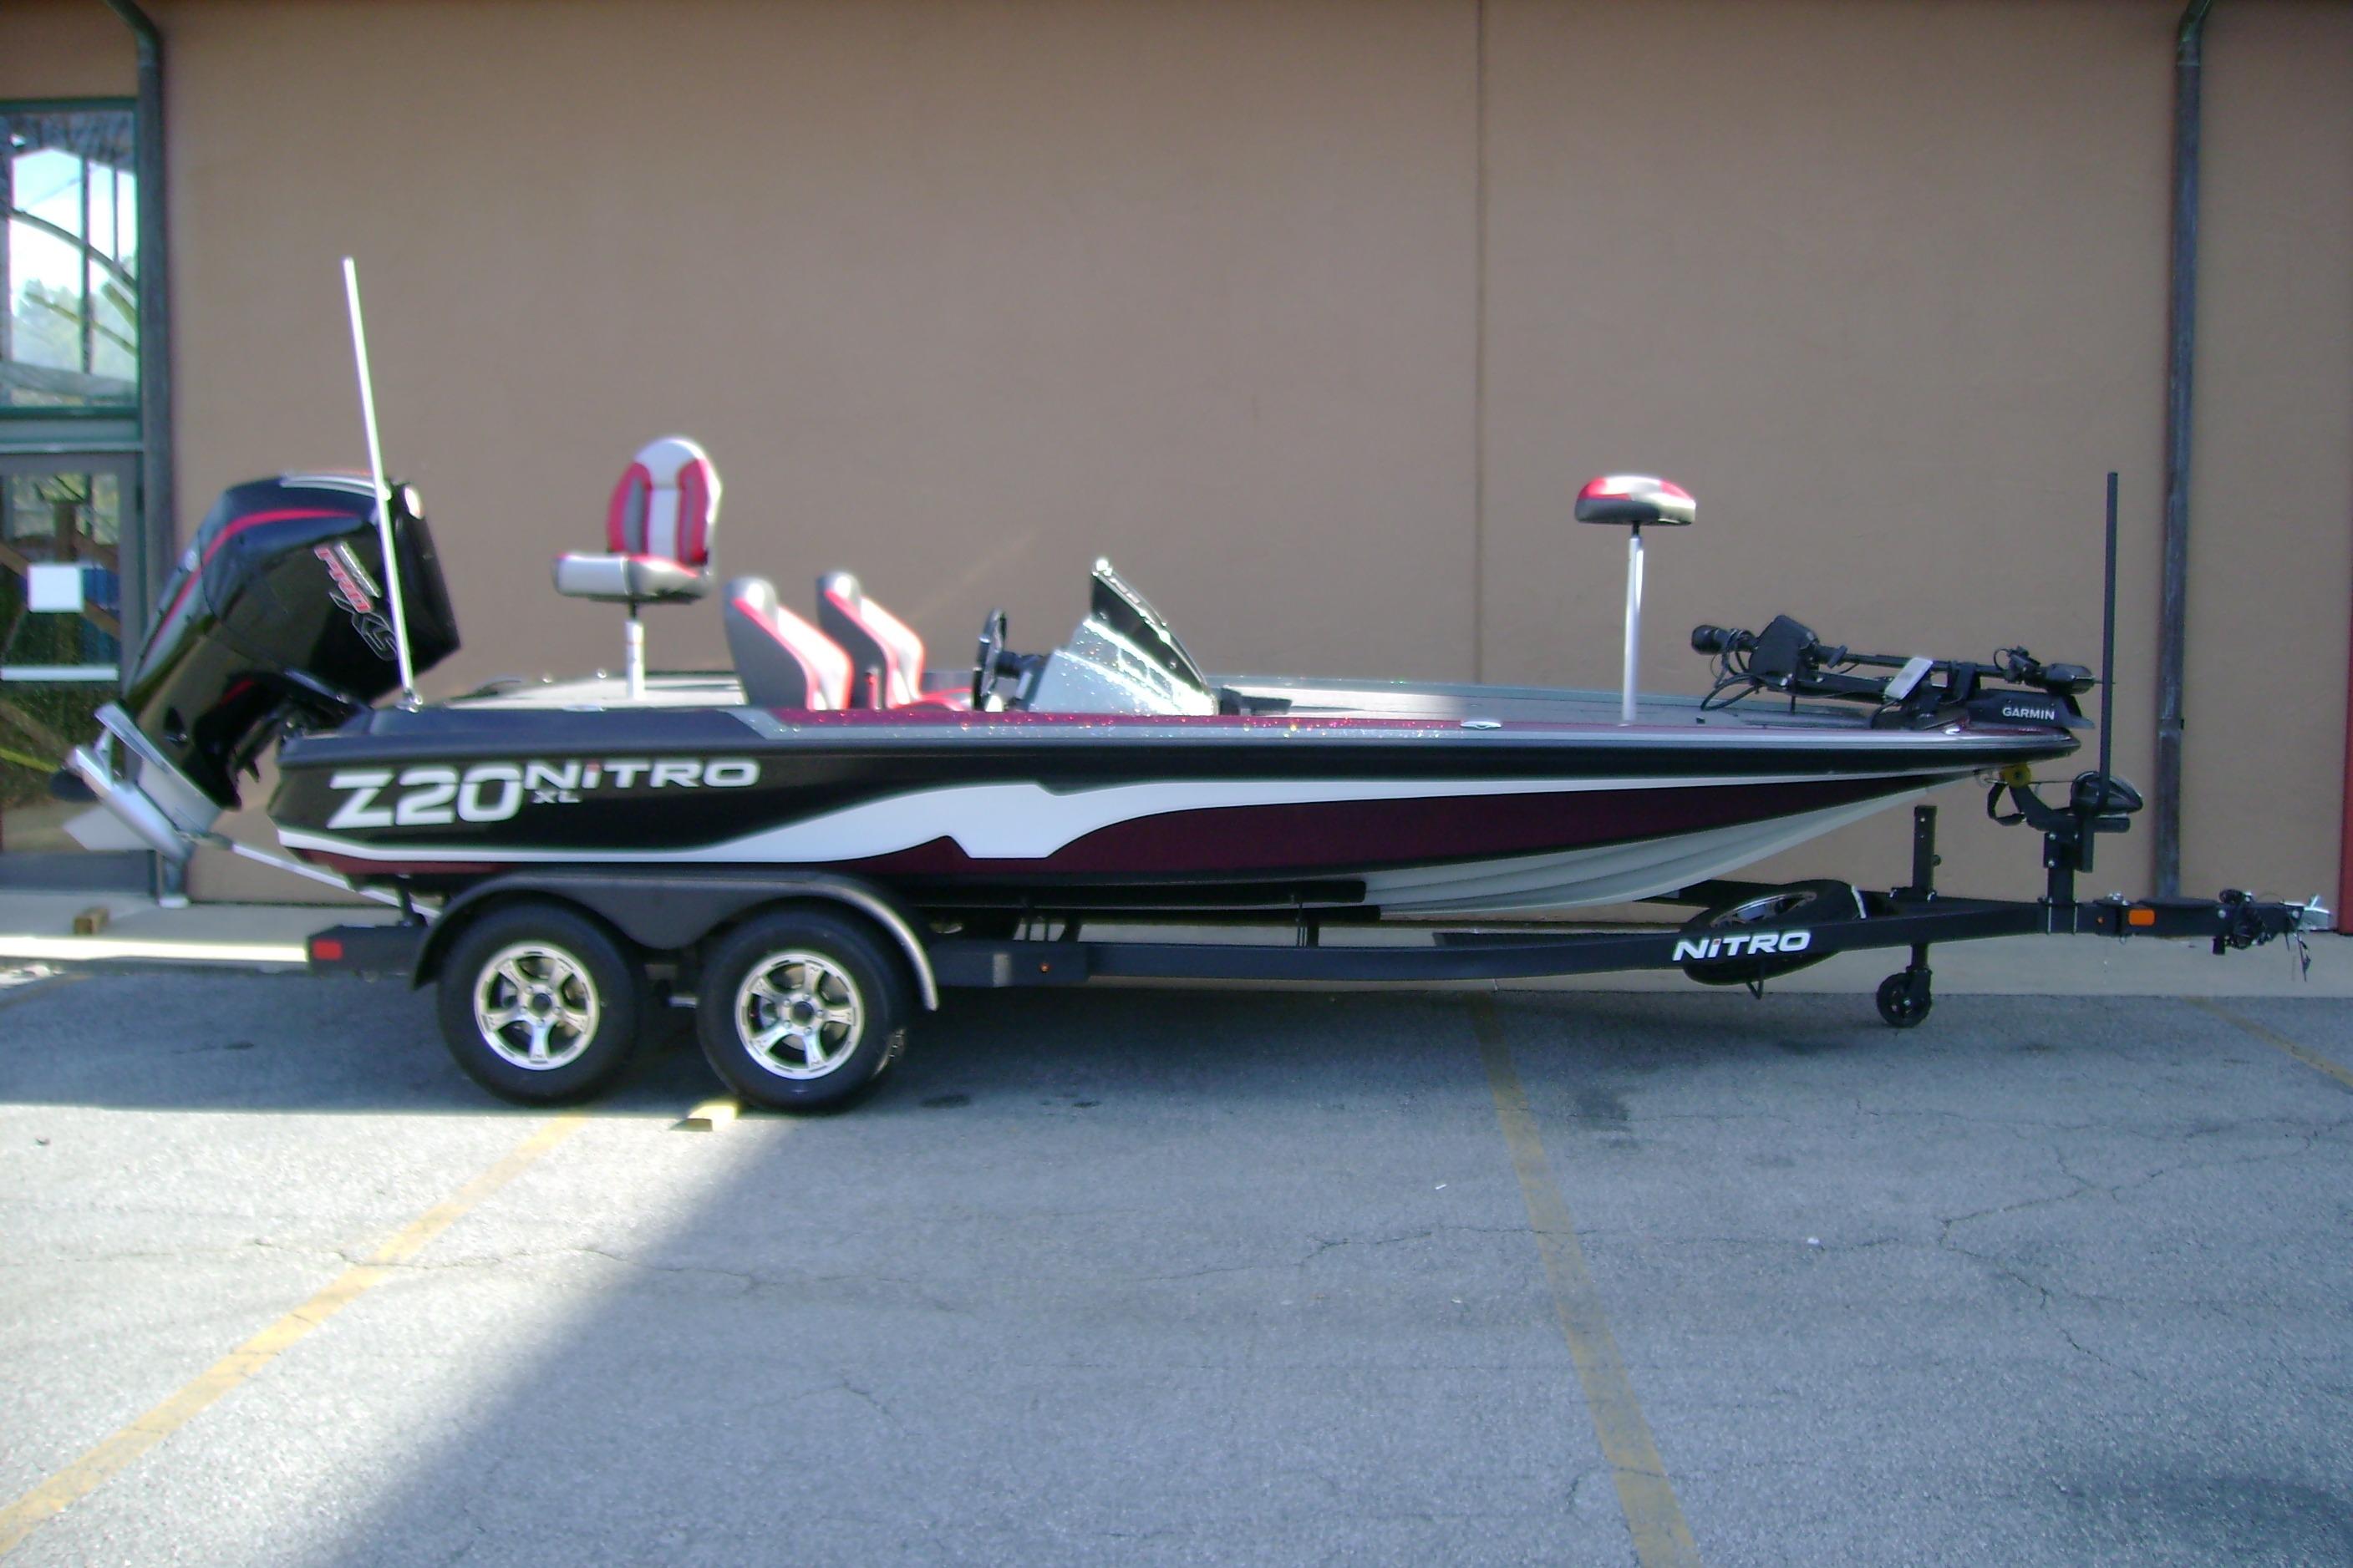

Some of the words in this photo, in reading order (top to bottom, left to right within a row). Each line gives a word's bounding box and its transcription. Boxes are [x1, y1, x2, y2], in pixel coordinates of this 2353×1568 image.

[2002, 707, 2055, 720] GARMIN
[327, 764, 523, 830] Z20
[532, 789, 582, 804] XL
